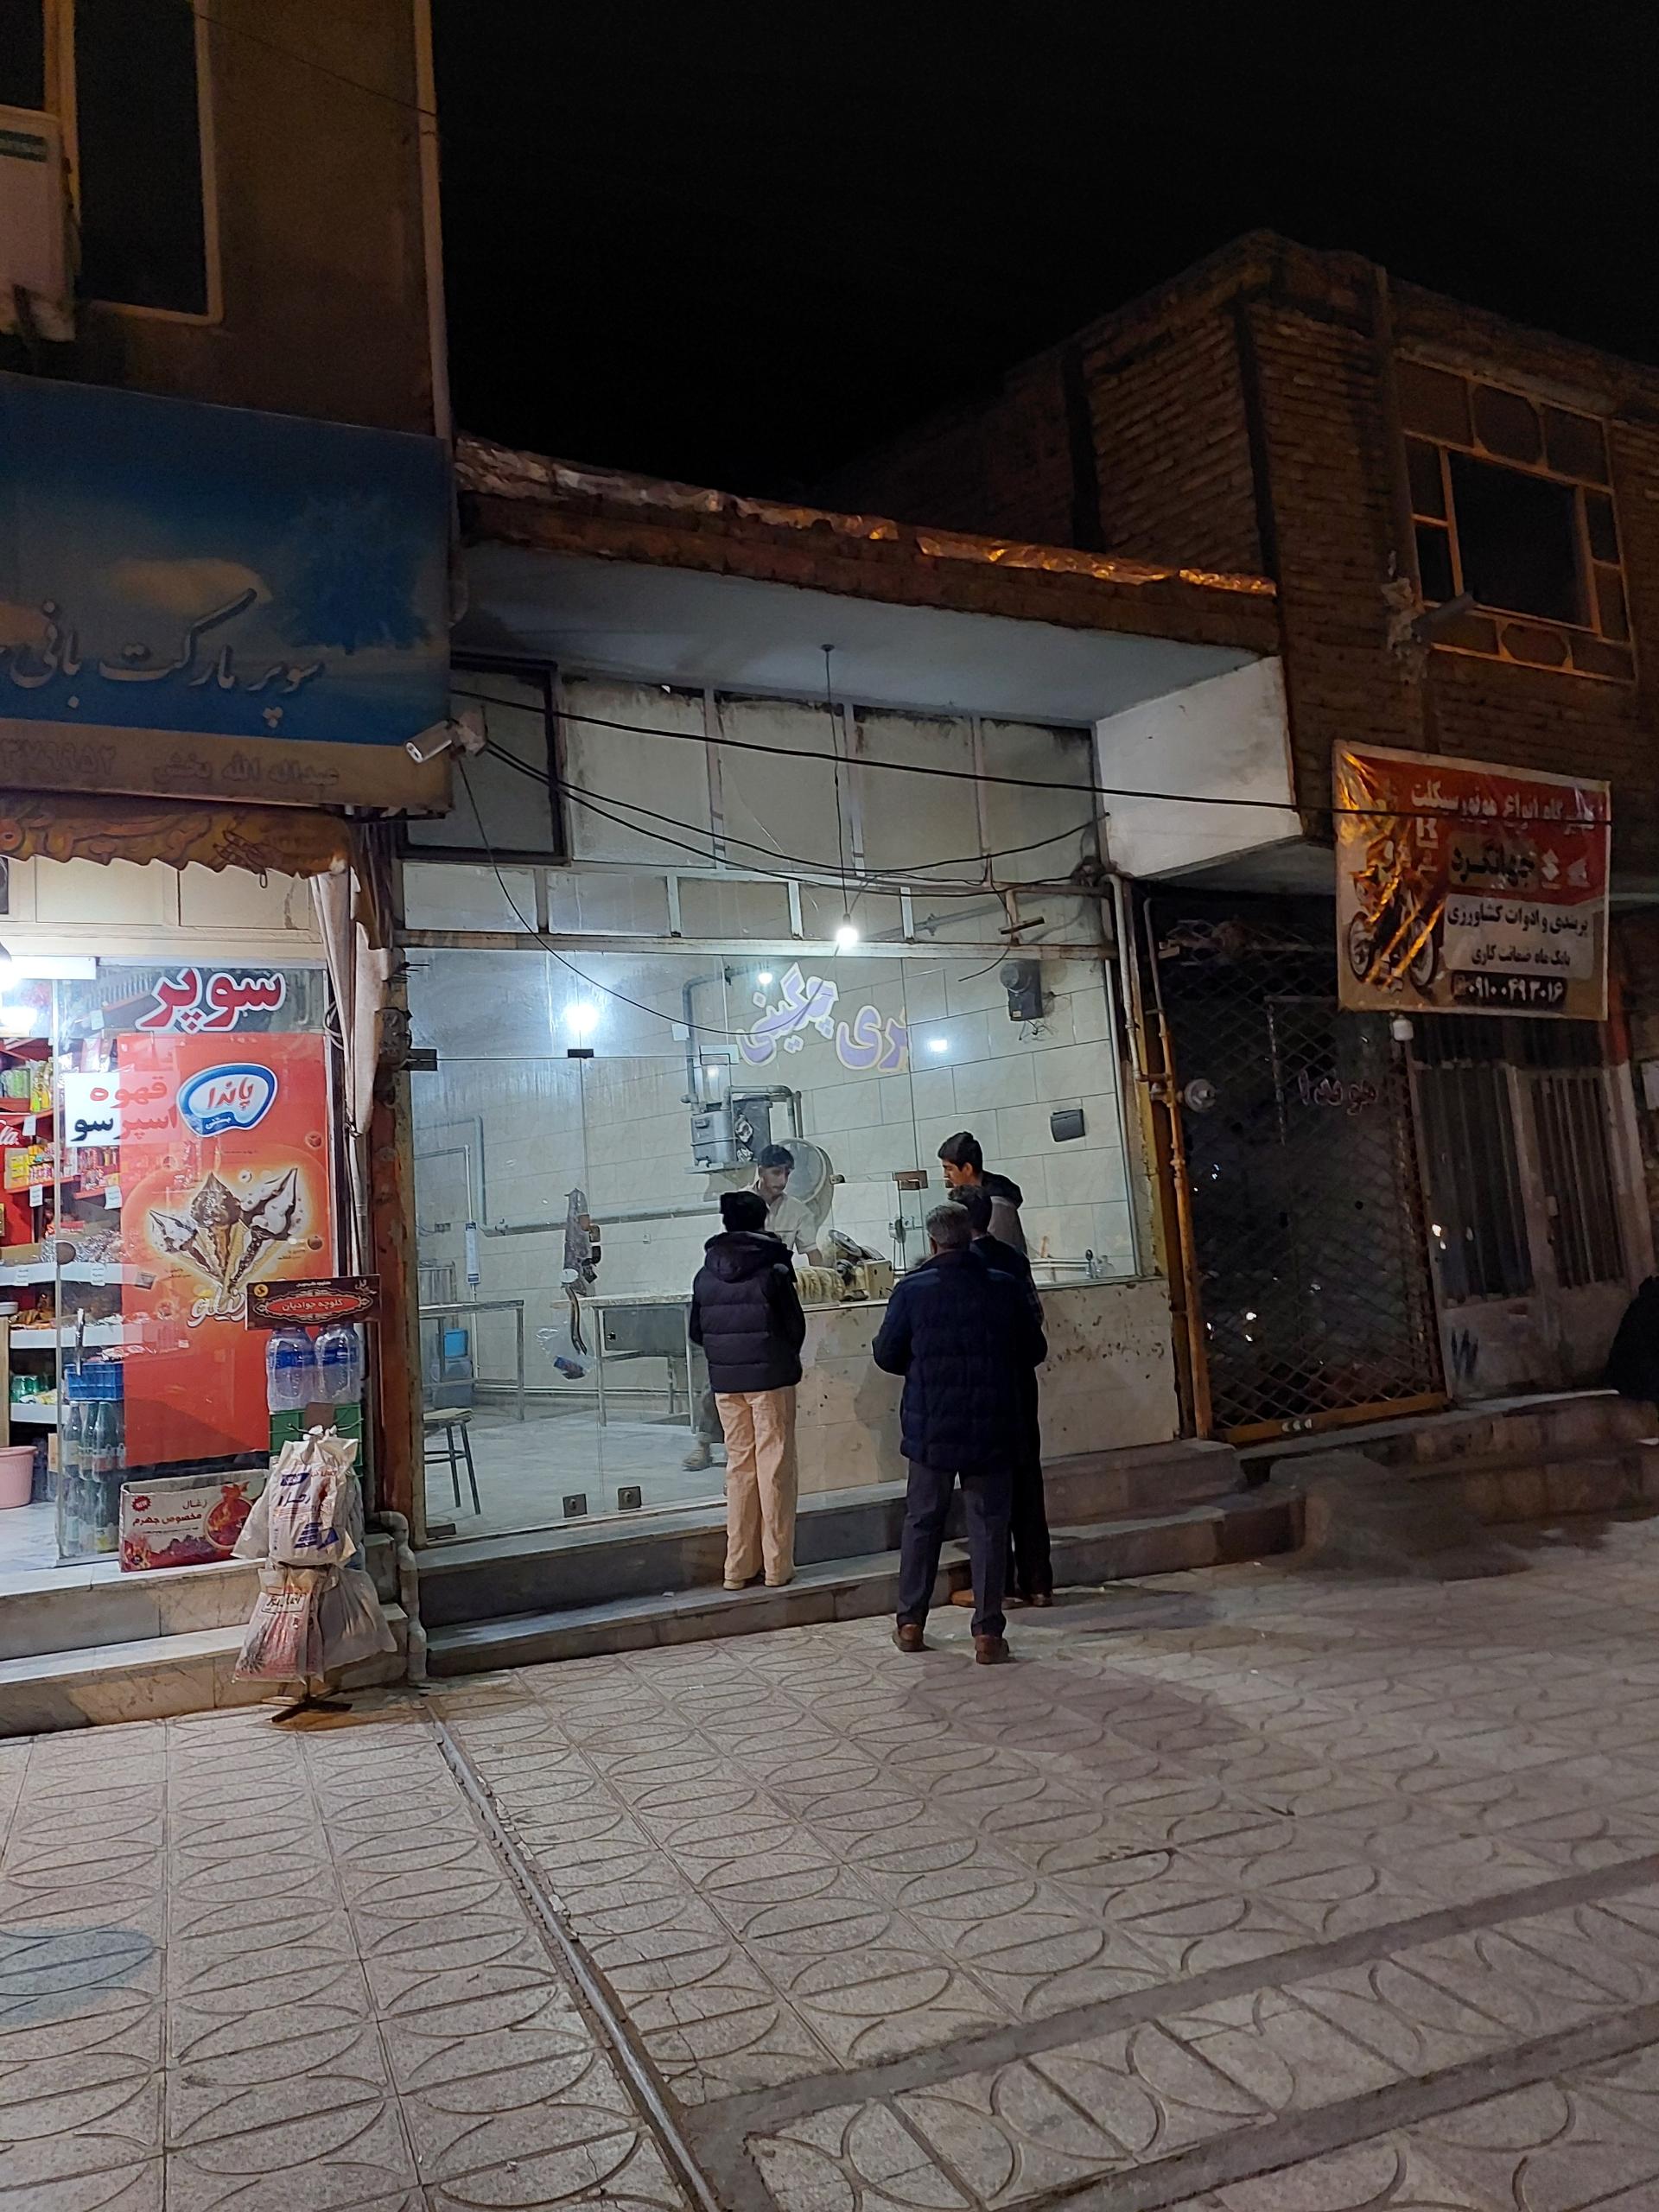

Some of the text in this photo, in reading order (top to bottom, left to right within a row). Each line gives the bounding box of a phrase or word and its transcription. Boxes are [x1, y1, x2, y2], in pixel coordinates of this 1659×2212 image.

[1447, 903, 1503, 927] کشاورزی
[135, 966, 286, 1034] سوپر
[89, 1076, 168, 1109] قهوه
[207, 1077, 255, 1112] پاندا
[70, 1108, 178, 1141] اسپرسو
